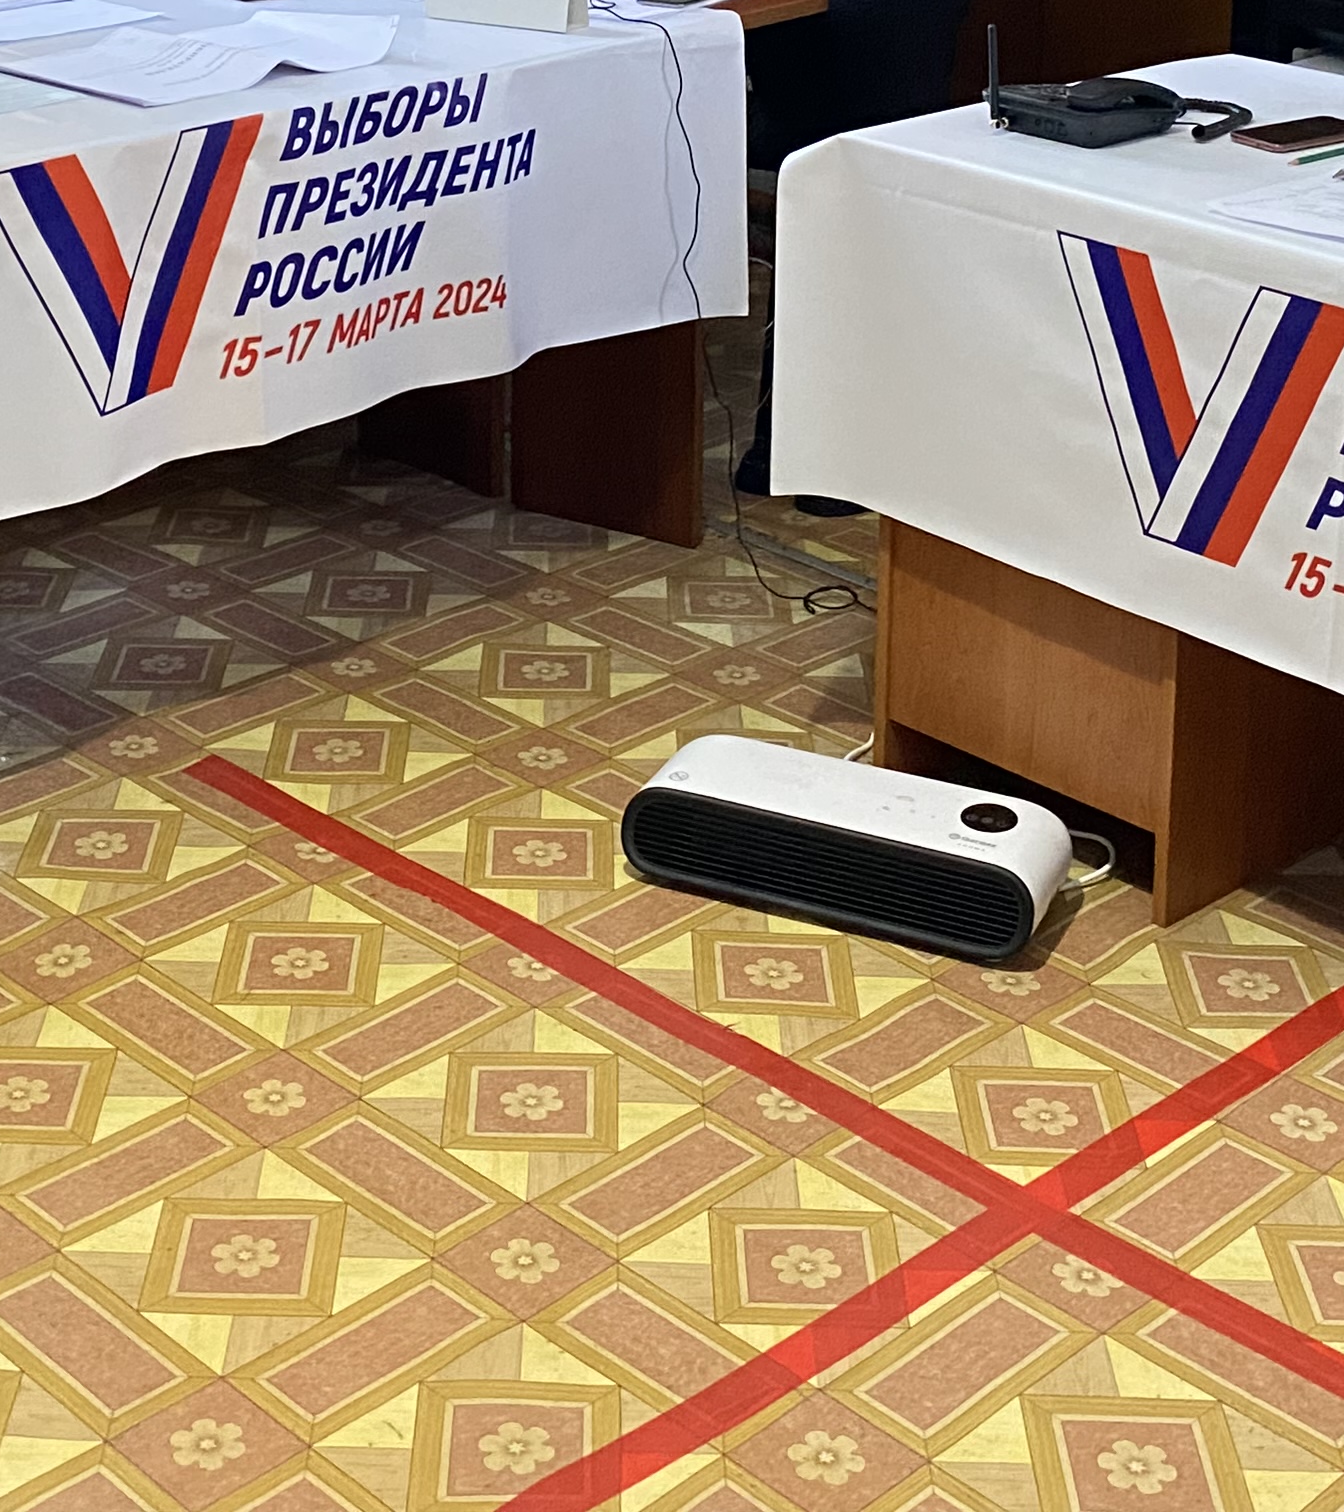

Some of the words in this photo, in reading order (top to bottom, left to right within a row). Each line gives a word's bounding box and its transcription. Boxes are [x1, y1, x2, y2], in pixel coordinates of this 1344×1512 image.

[280, 72, 488, 162] ВЫБОРЫ
[258, 128, 536, 239] ПРЕЗИДЕНТА
[234, 221, 425, 317] РОССИИ
[326, 288, 425, 355] МАРТА
[432, 275, 508, 320] 2024
